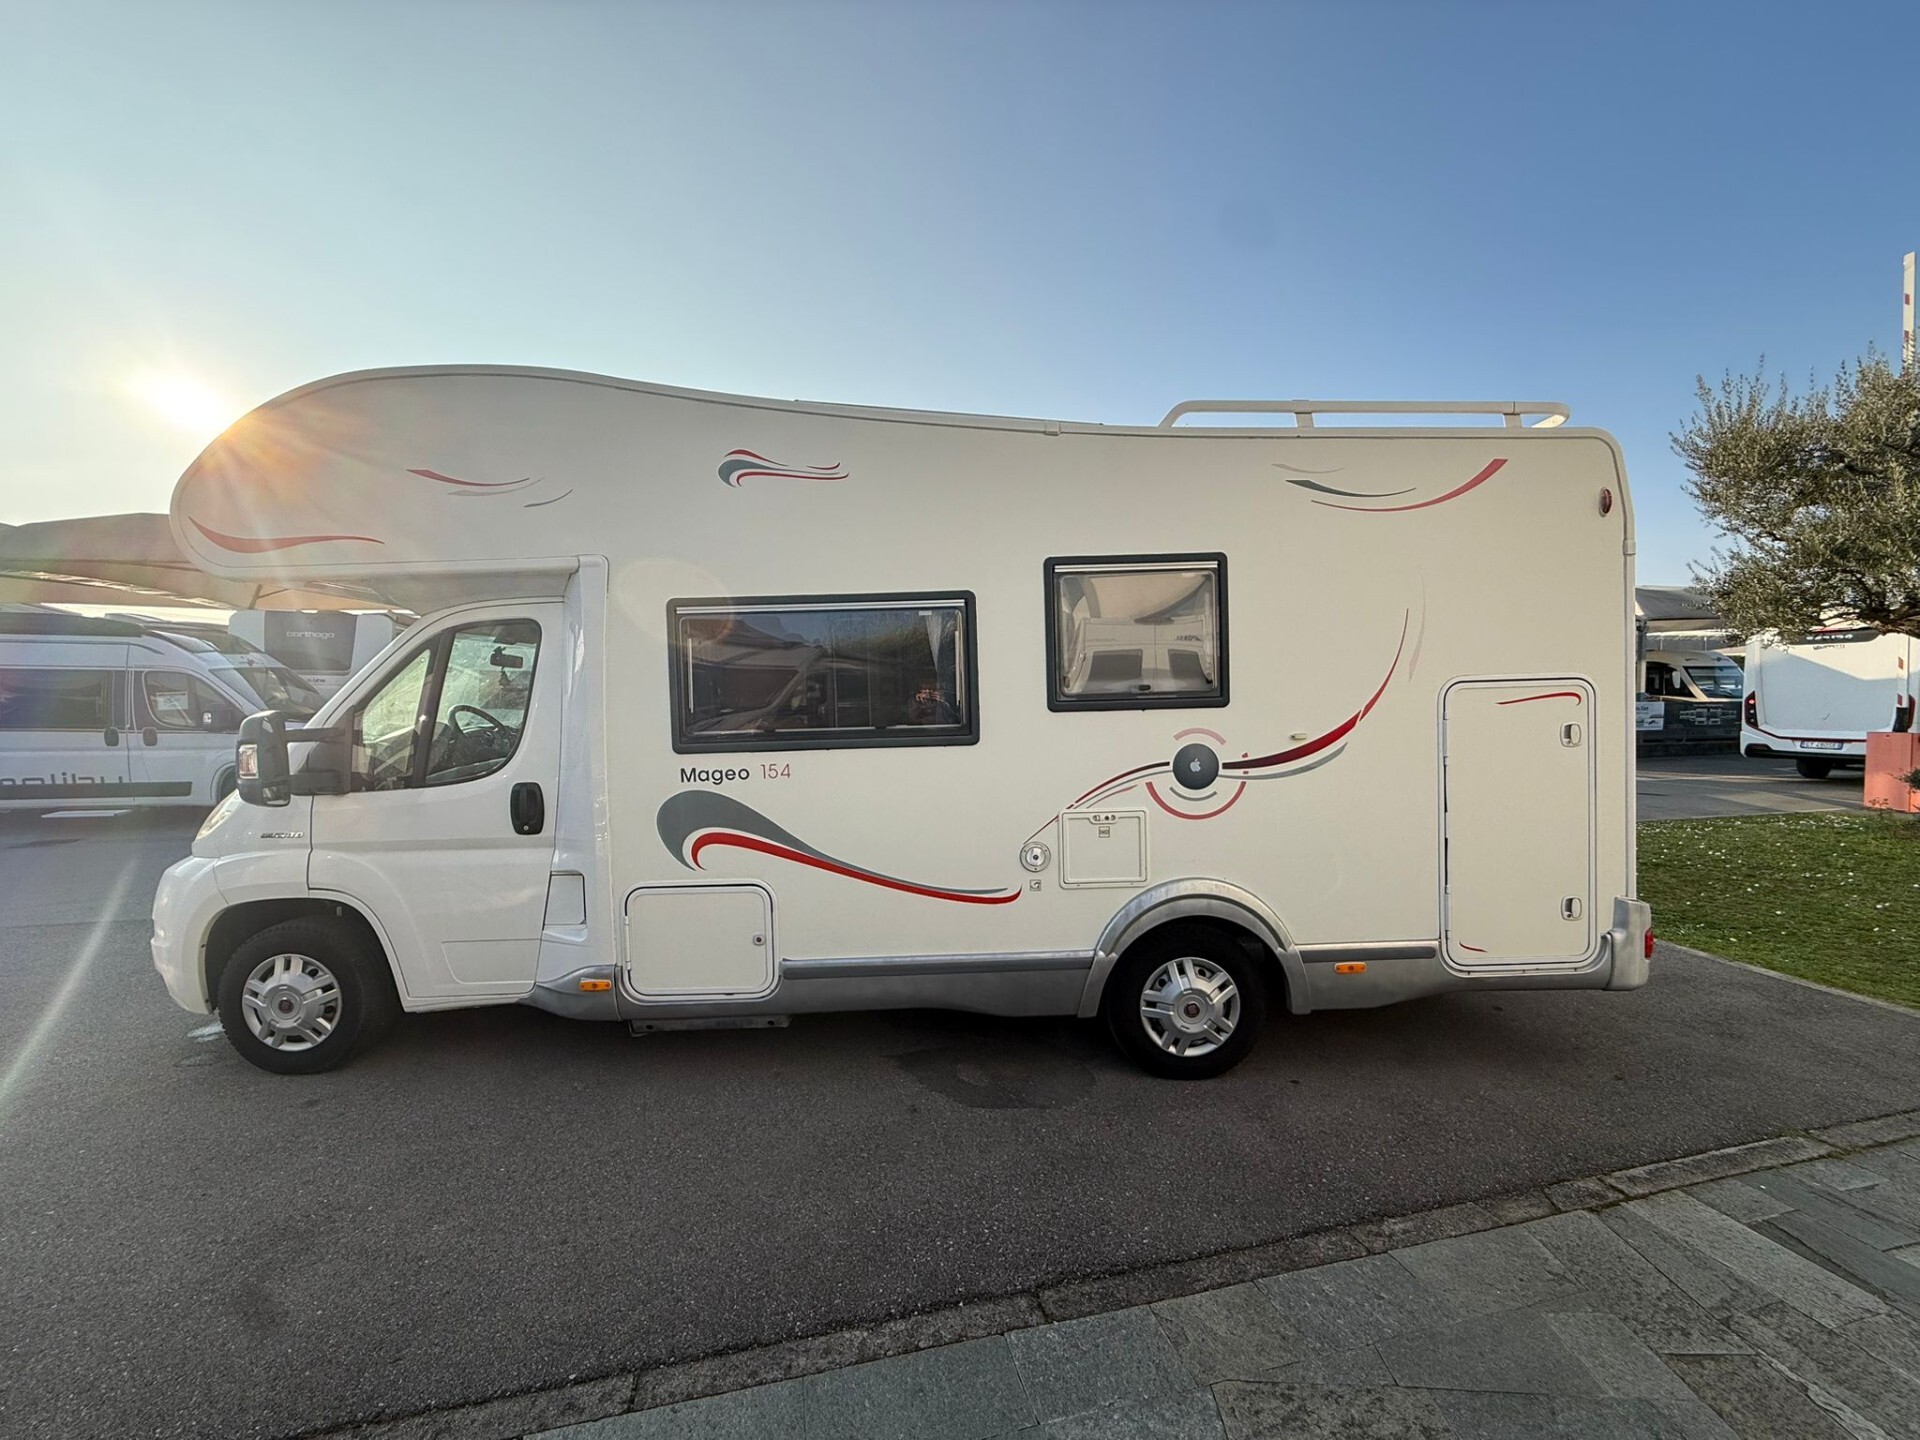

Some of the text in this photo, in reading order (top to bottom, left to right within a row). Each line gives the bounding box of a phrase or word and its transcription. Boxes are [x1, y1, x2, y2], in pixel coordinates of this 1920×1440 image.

[286, 631, 335, 640] carthago
[680, 763, 791, 786] Mageo 154
